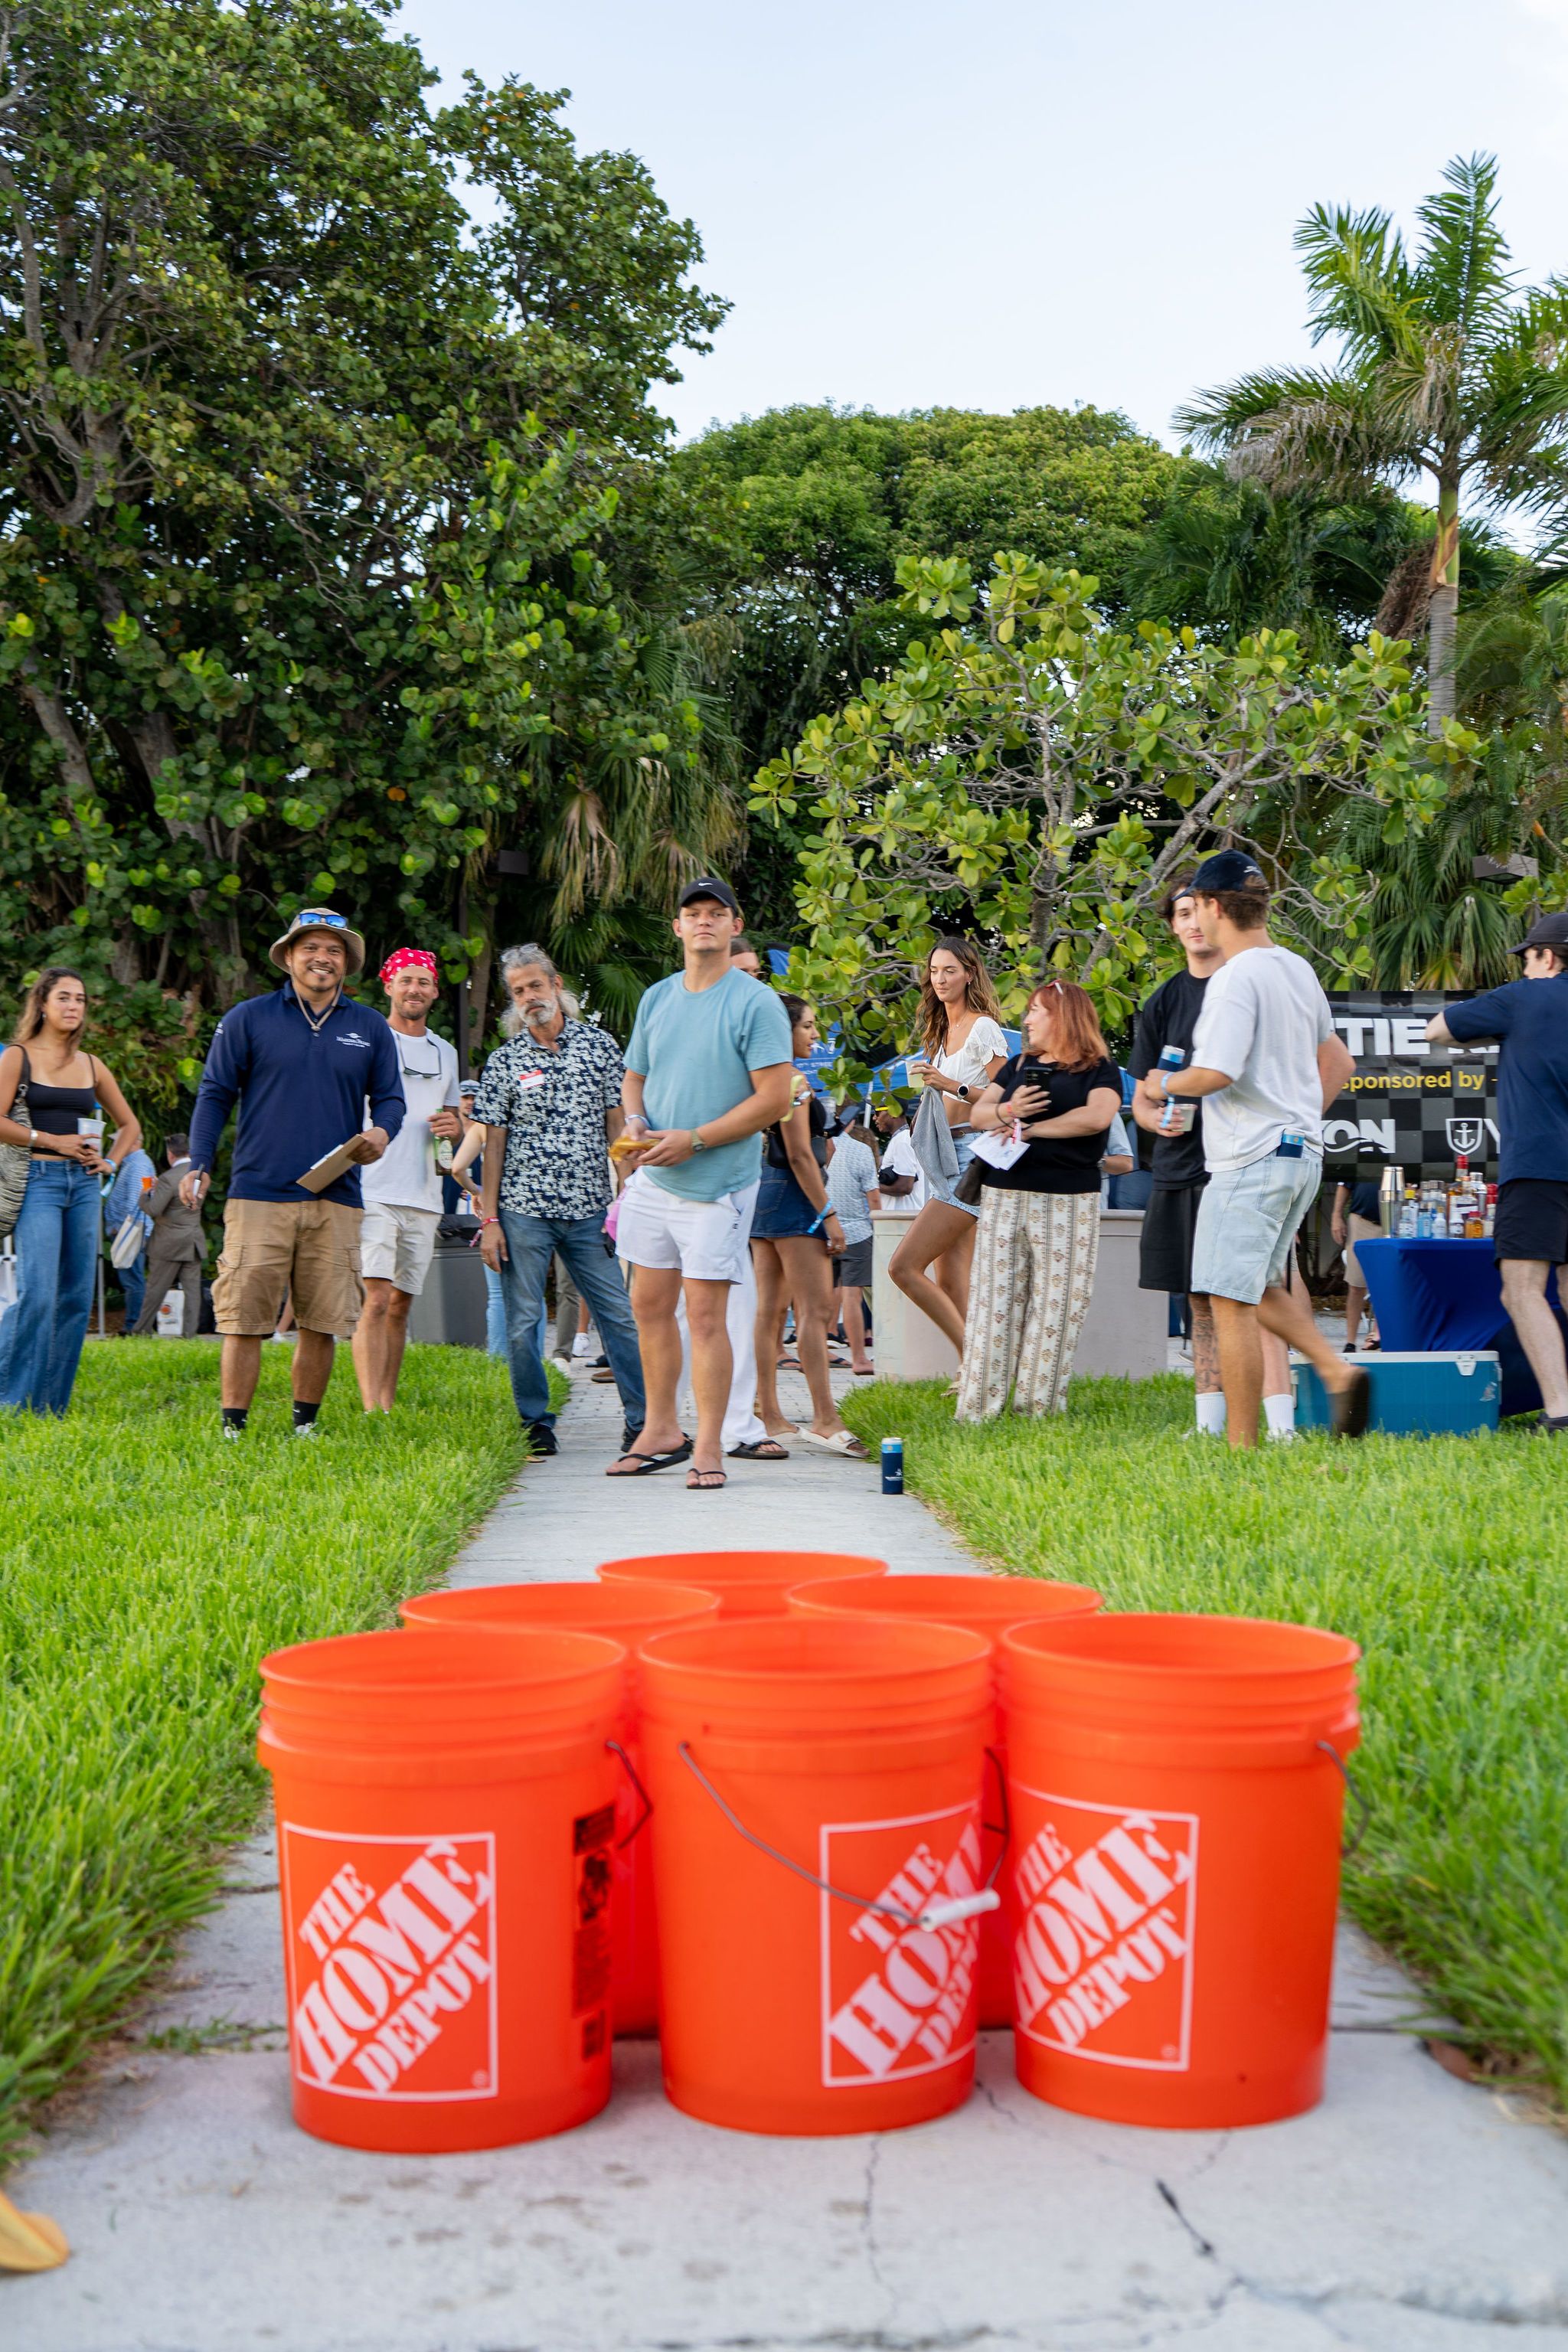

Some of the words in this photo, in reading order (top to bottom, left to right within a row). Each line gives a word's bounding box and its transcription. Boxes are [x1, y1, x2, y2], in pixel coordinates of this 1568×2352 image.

[1330, 1018, 1430, 1057] TIE
[1458, 1071, 1485, 1090] by
[299, 1861, 376, 1962] THE
[849, 1842, 945, 1953] THE
[1015, 1822, 1073, 1909] THE
[294, 1839, 492, 2086] HOME
[1014, 1815, 1191, 2029] HOME
[1046, 1906, 1188, 2047] DEPOT
[351, 1930, 492, 2095] DEPOT
